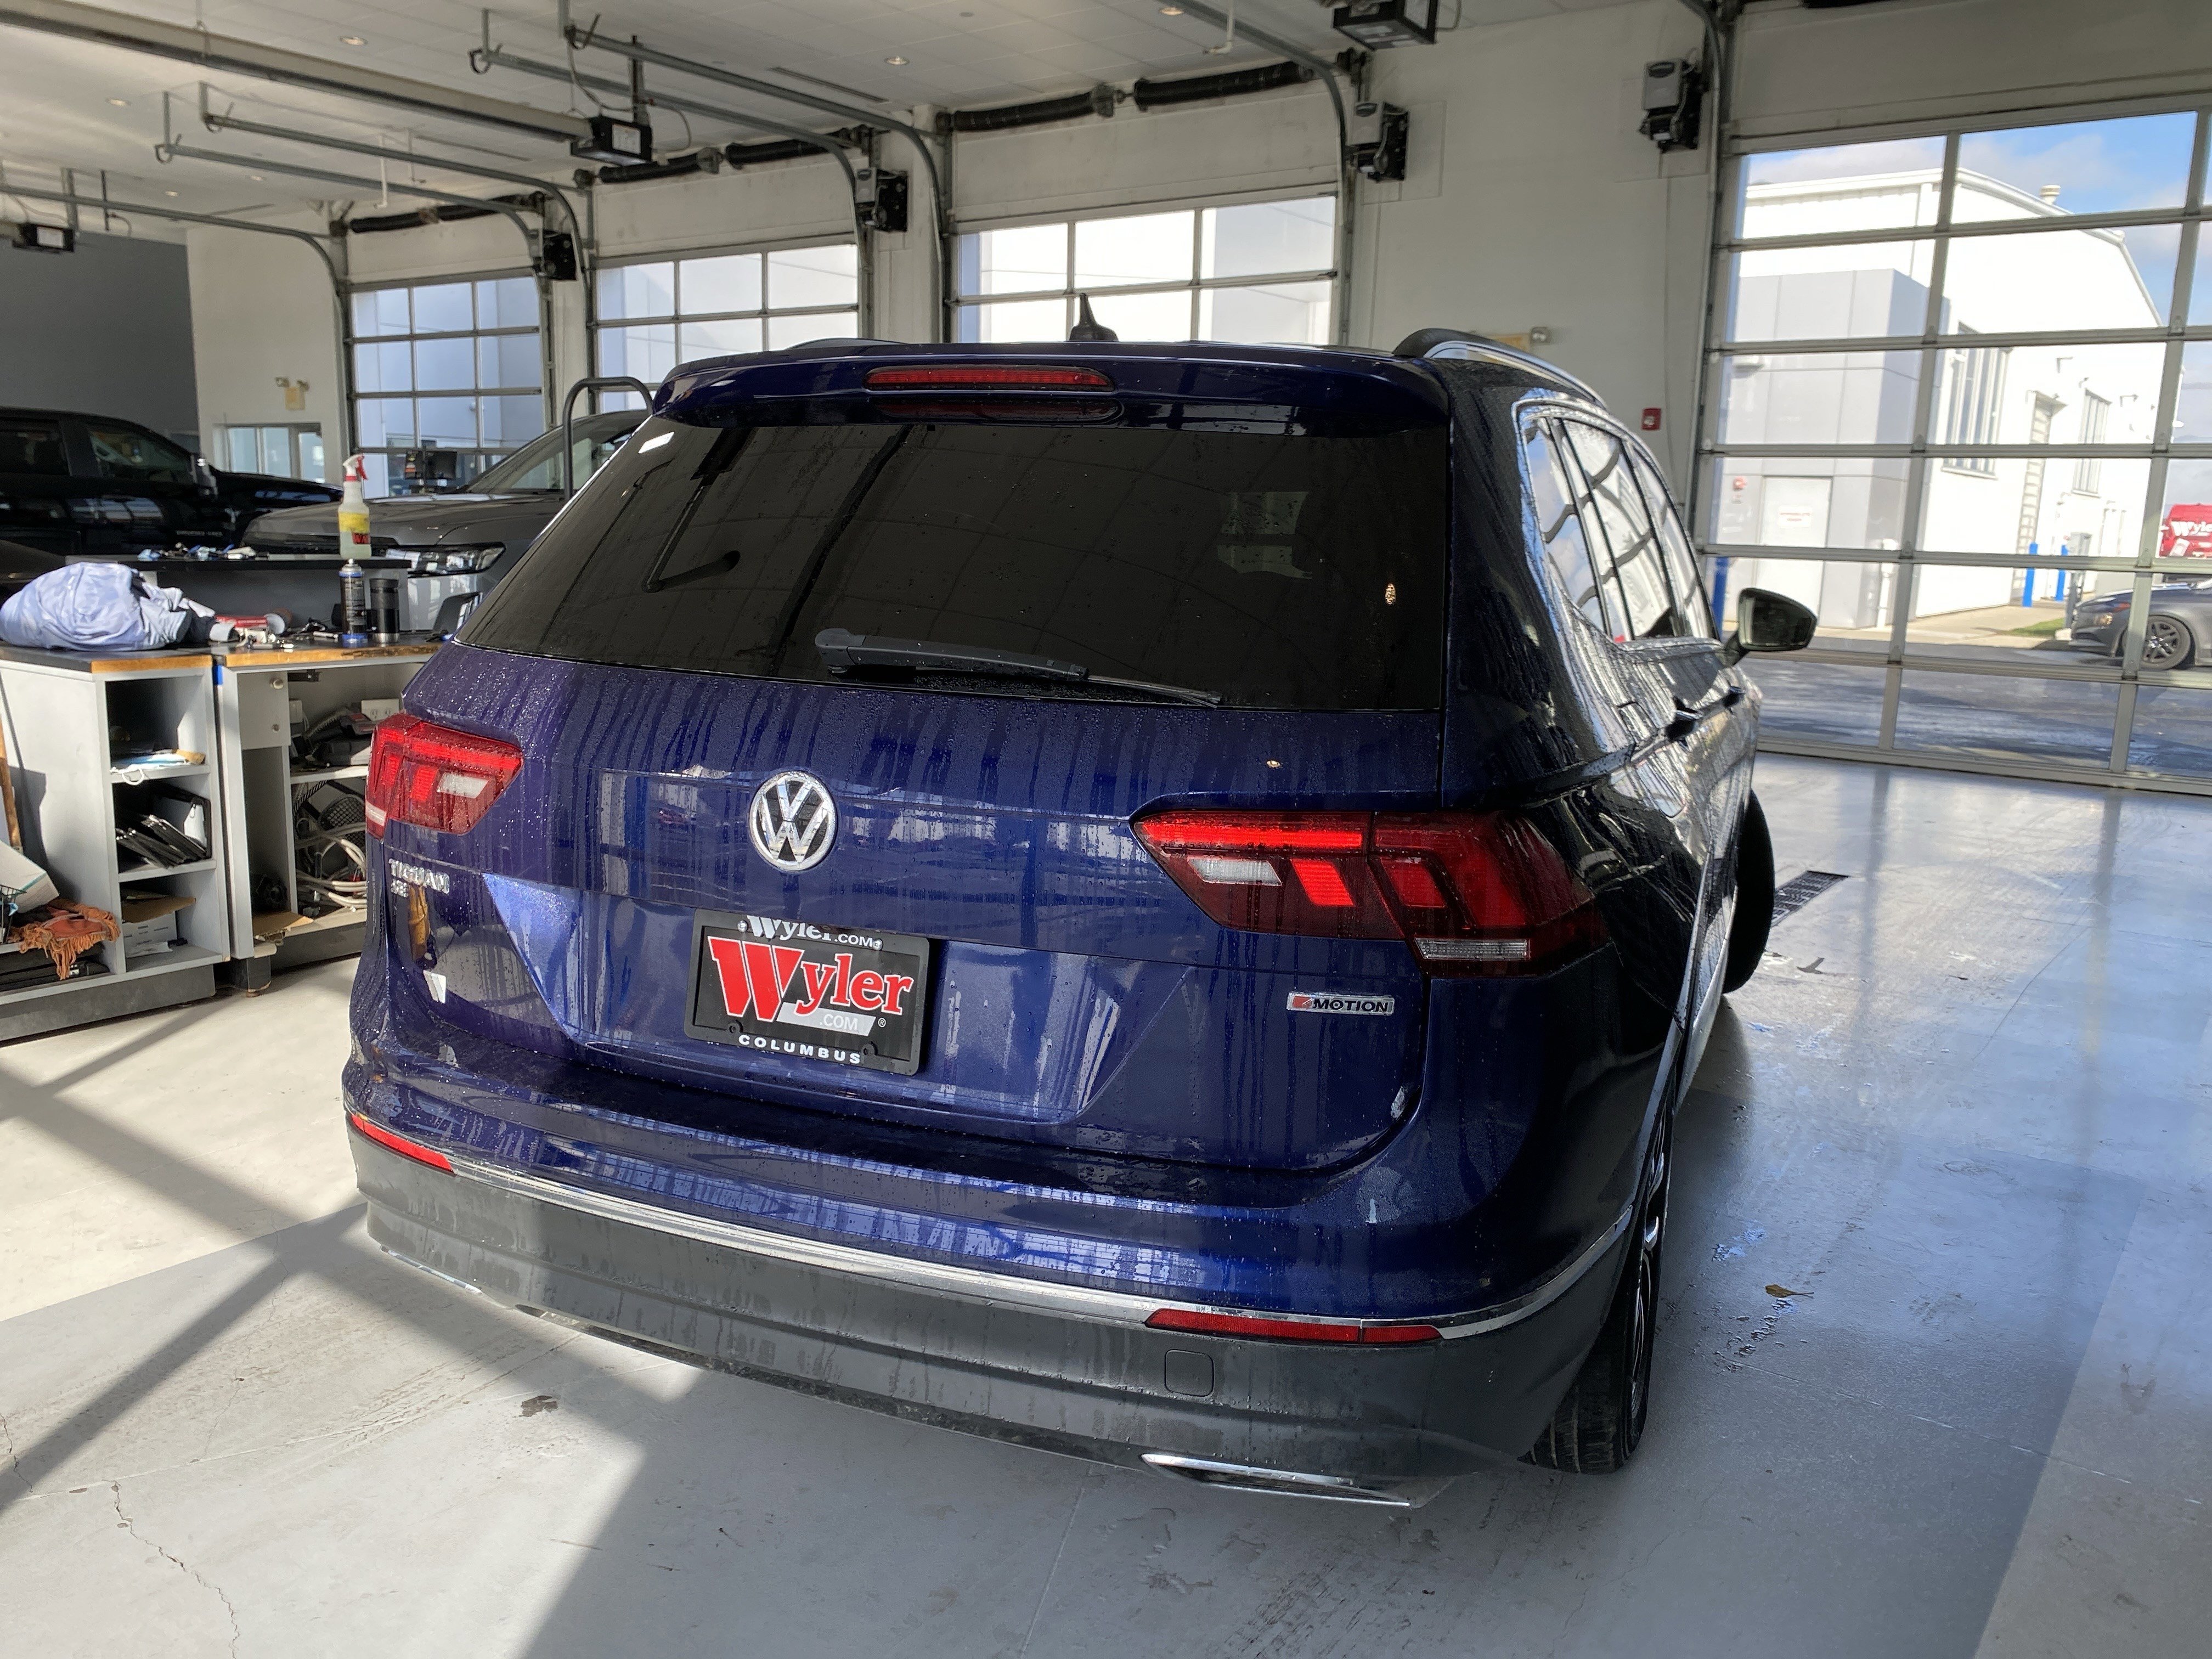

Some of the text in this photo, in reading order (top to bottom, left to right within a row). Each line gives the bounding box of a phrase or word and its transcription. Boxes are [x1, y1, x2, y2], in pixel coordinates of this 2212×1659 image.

[388, 858, 450, 894] TIGUAN
[707, 935, 915, 1023] Wyler
[738, 1034, 861, 1064] COLUMBUS
